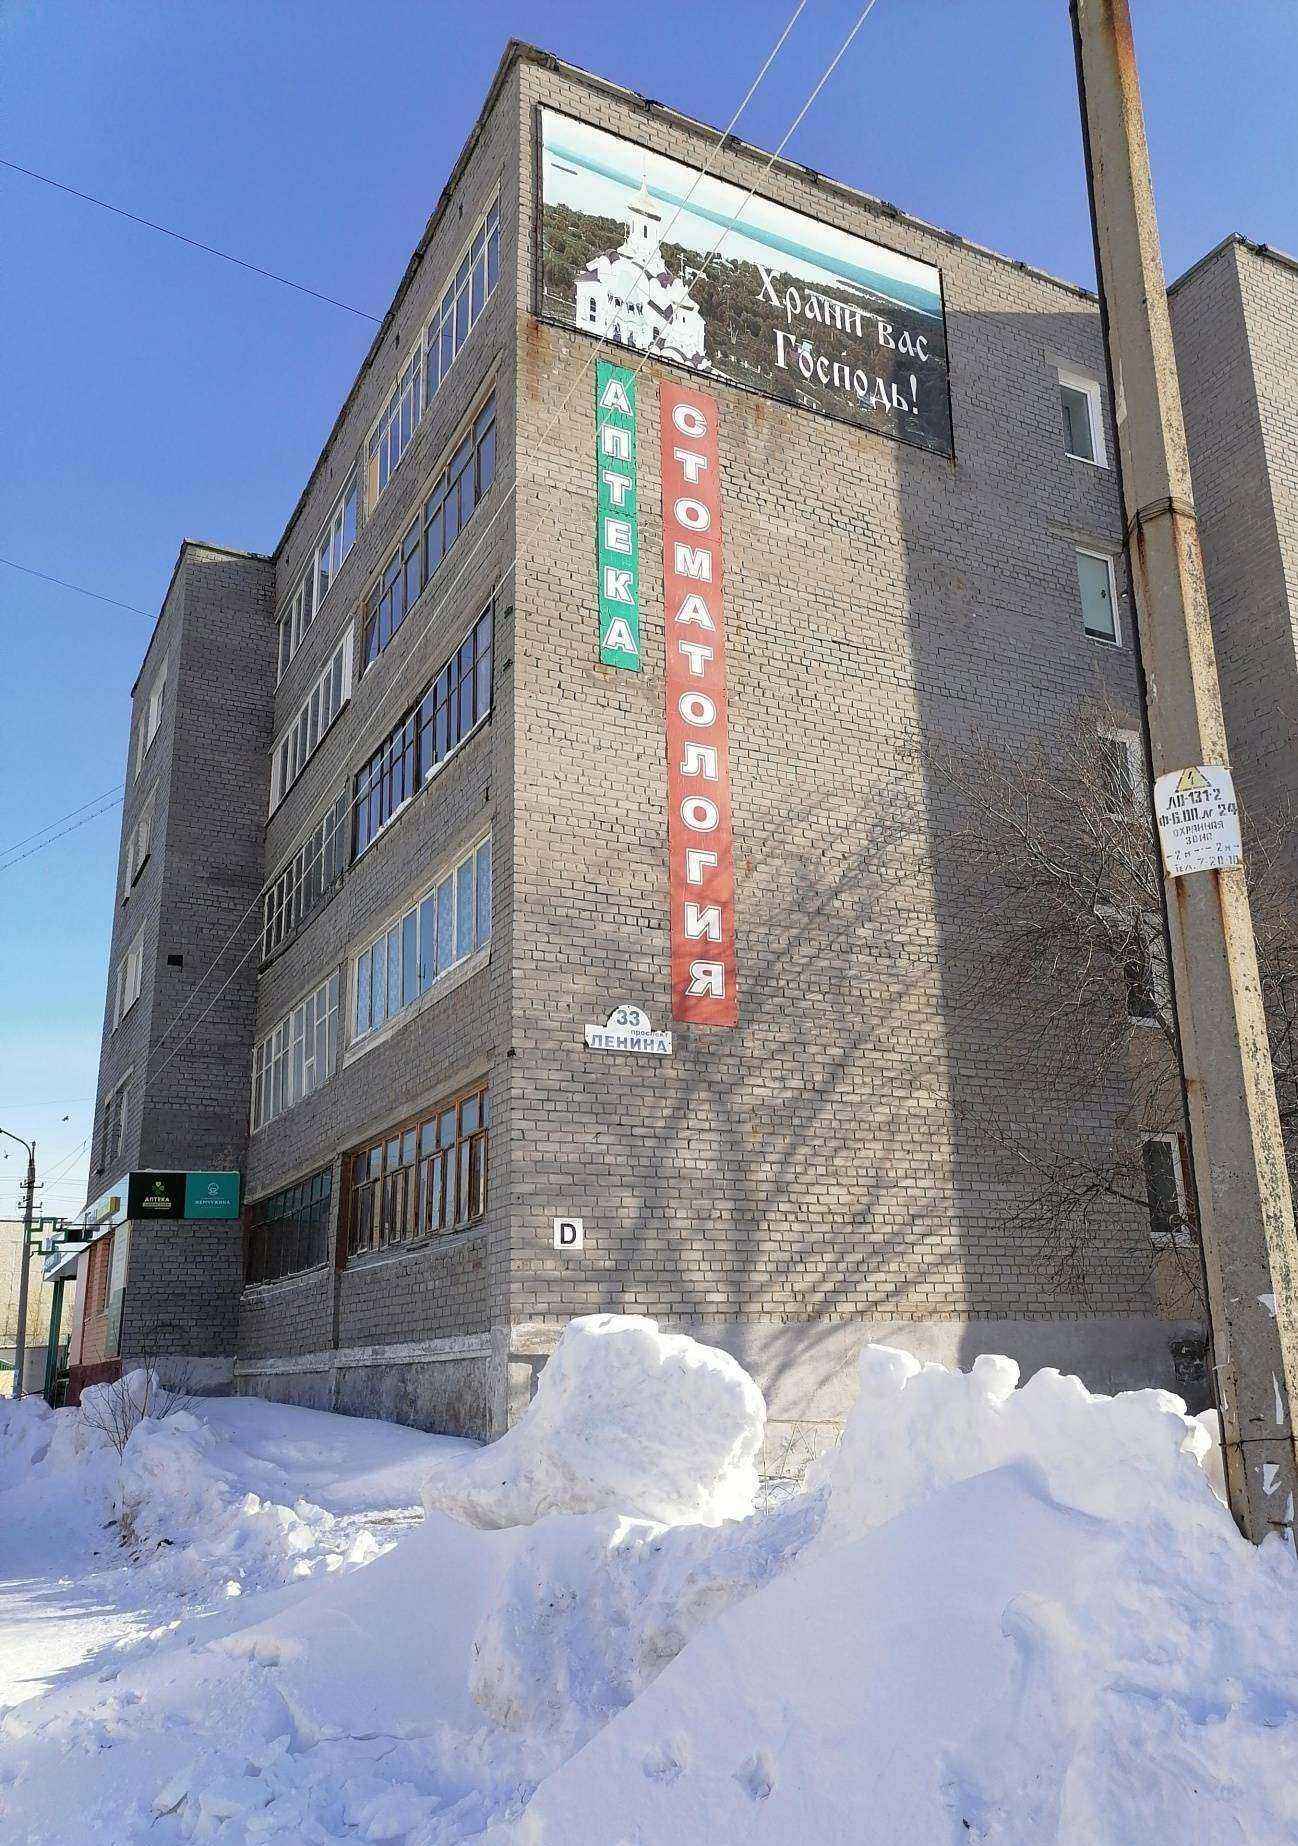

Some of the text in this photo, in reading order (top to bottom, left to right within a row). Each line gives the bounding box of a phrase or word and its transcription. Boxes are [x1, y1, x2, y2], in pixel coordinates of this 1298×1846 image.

[755, 262, 929, 362] Храни вас
[773, 328, 919, 414] Господь!
[600, 379, 638, 654] АПТЕКА
[671, 403, 726, 999] СТОМАТОЛОГИЯ
[1173, 820, 1224, 837] ОХРАННАЯ
[590, 1034, 668, 1053] ЛЕНИНА
[616, 1010, 640, 1026] 33
[560, 1223, 577, 1245] D
